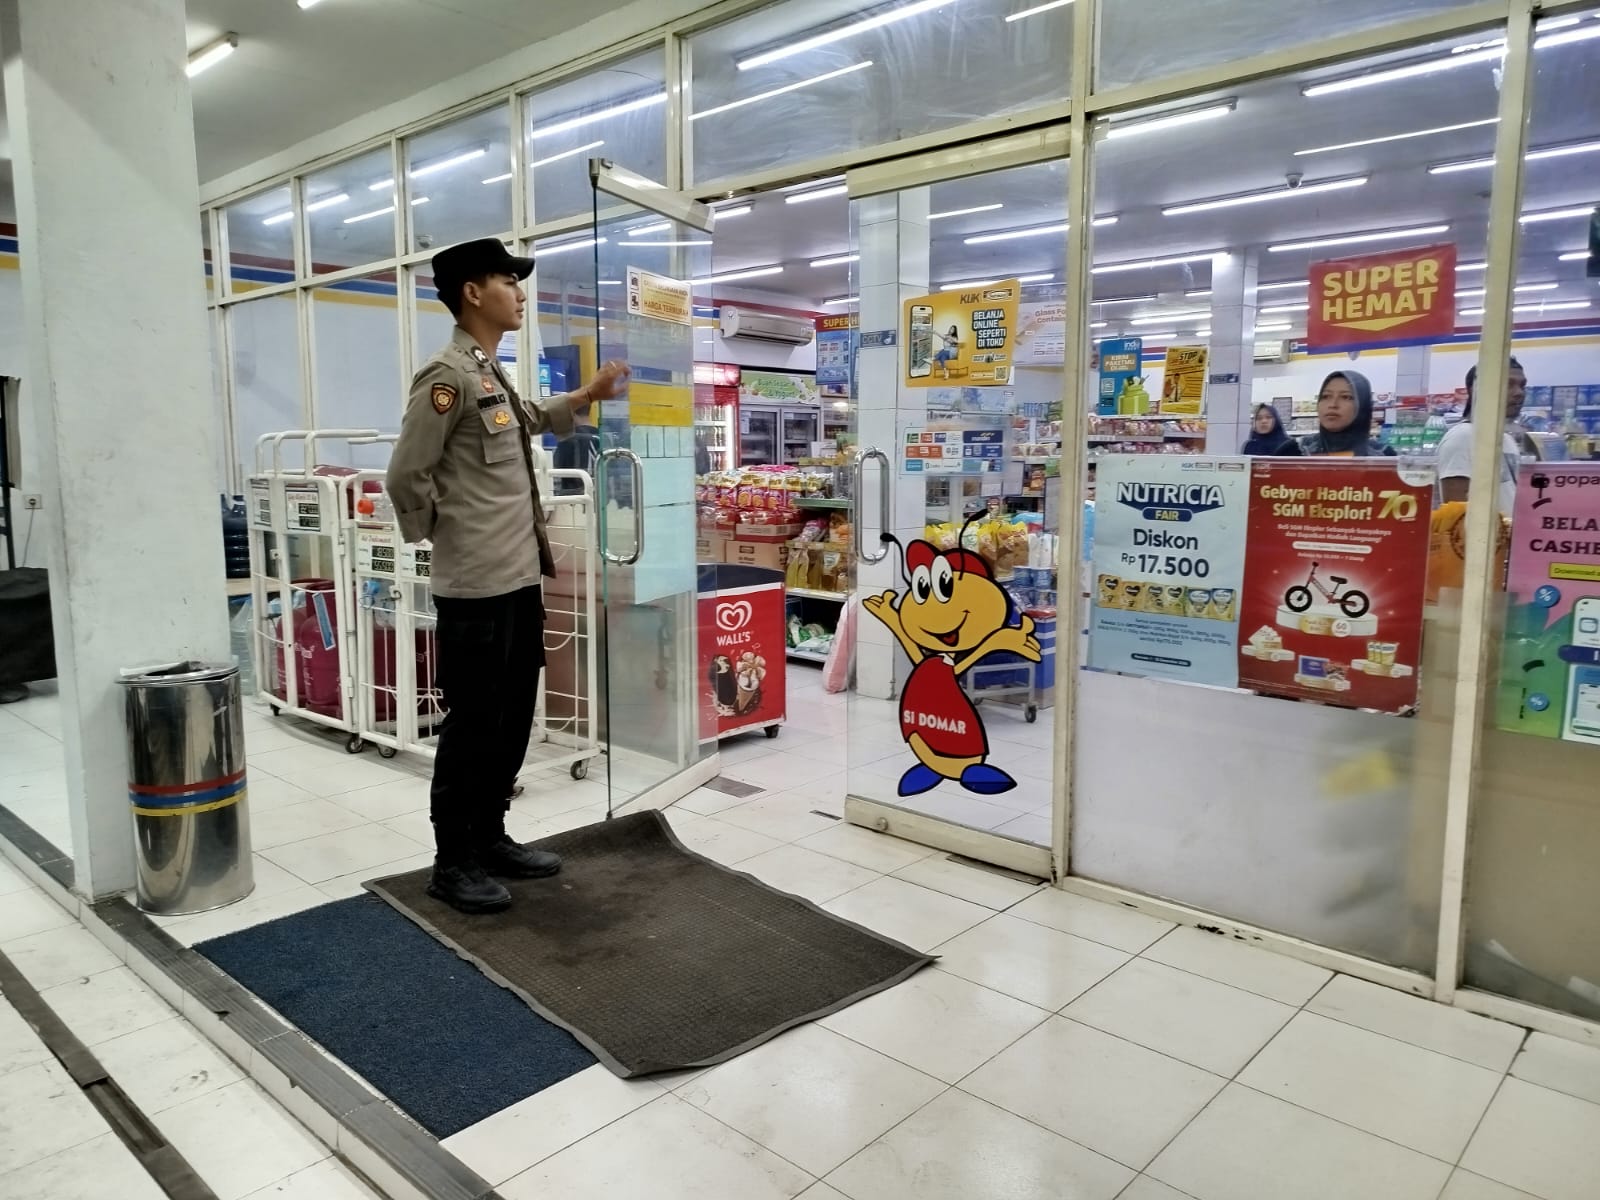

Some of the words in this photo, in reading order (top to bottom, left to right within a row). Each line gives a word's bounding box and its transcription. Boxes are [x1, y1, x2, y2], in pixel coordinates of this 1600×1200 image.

[1322, 259, 1439, 297] SUPER
[1322, 286, 1439, 322] HEMAT
[973, 309, 1004, 320] BELANJA
[973, 319, 998, 329] ONLINE
[978, 328, 1006, 338] SEPERTI
[978, 338, 985, 348] DI
[986, 337, 1004, 347] TOKO
[1116, 482, 1225, 507] NUTRICIA
[1260, 484, 1313, 503] Gebyar
[1317, 486, 1374, 503] Hadiah
[1155, 509, 1179, 521] FAIR
[1273, 503, 1305, 518] SGM
[1309, 504, 1372, 522] Eksplor!
[1133, 528, 1198, 550] Diskon
[1121, 552, 1136, 566] Rp
[1138, 553, 1210, 578] 17.500
[716, 631, 751, 647] WALL'S
[919, 711, 967, 735] DOMAR
